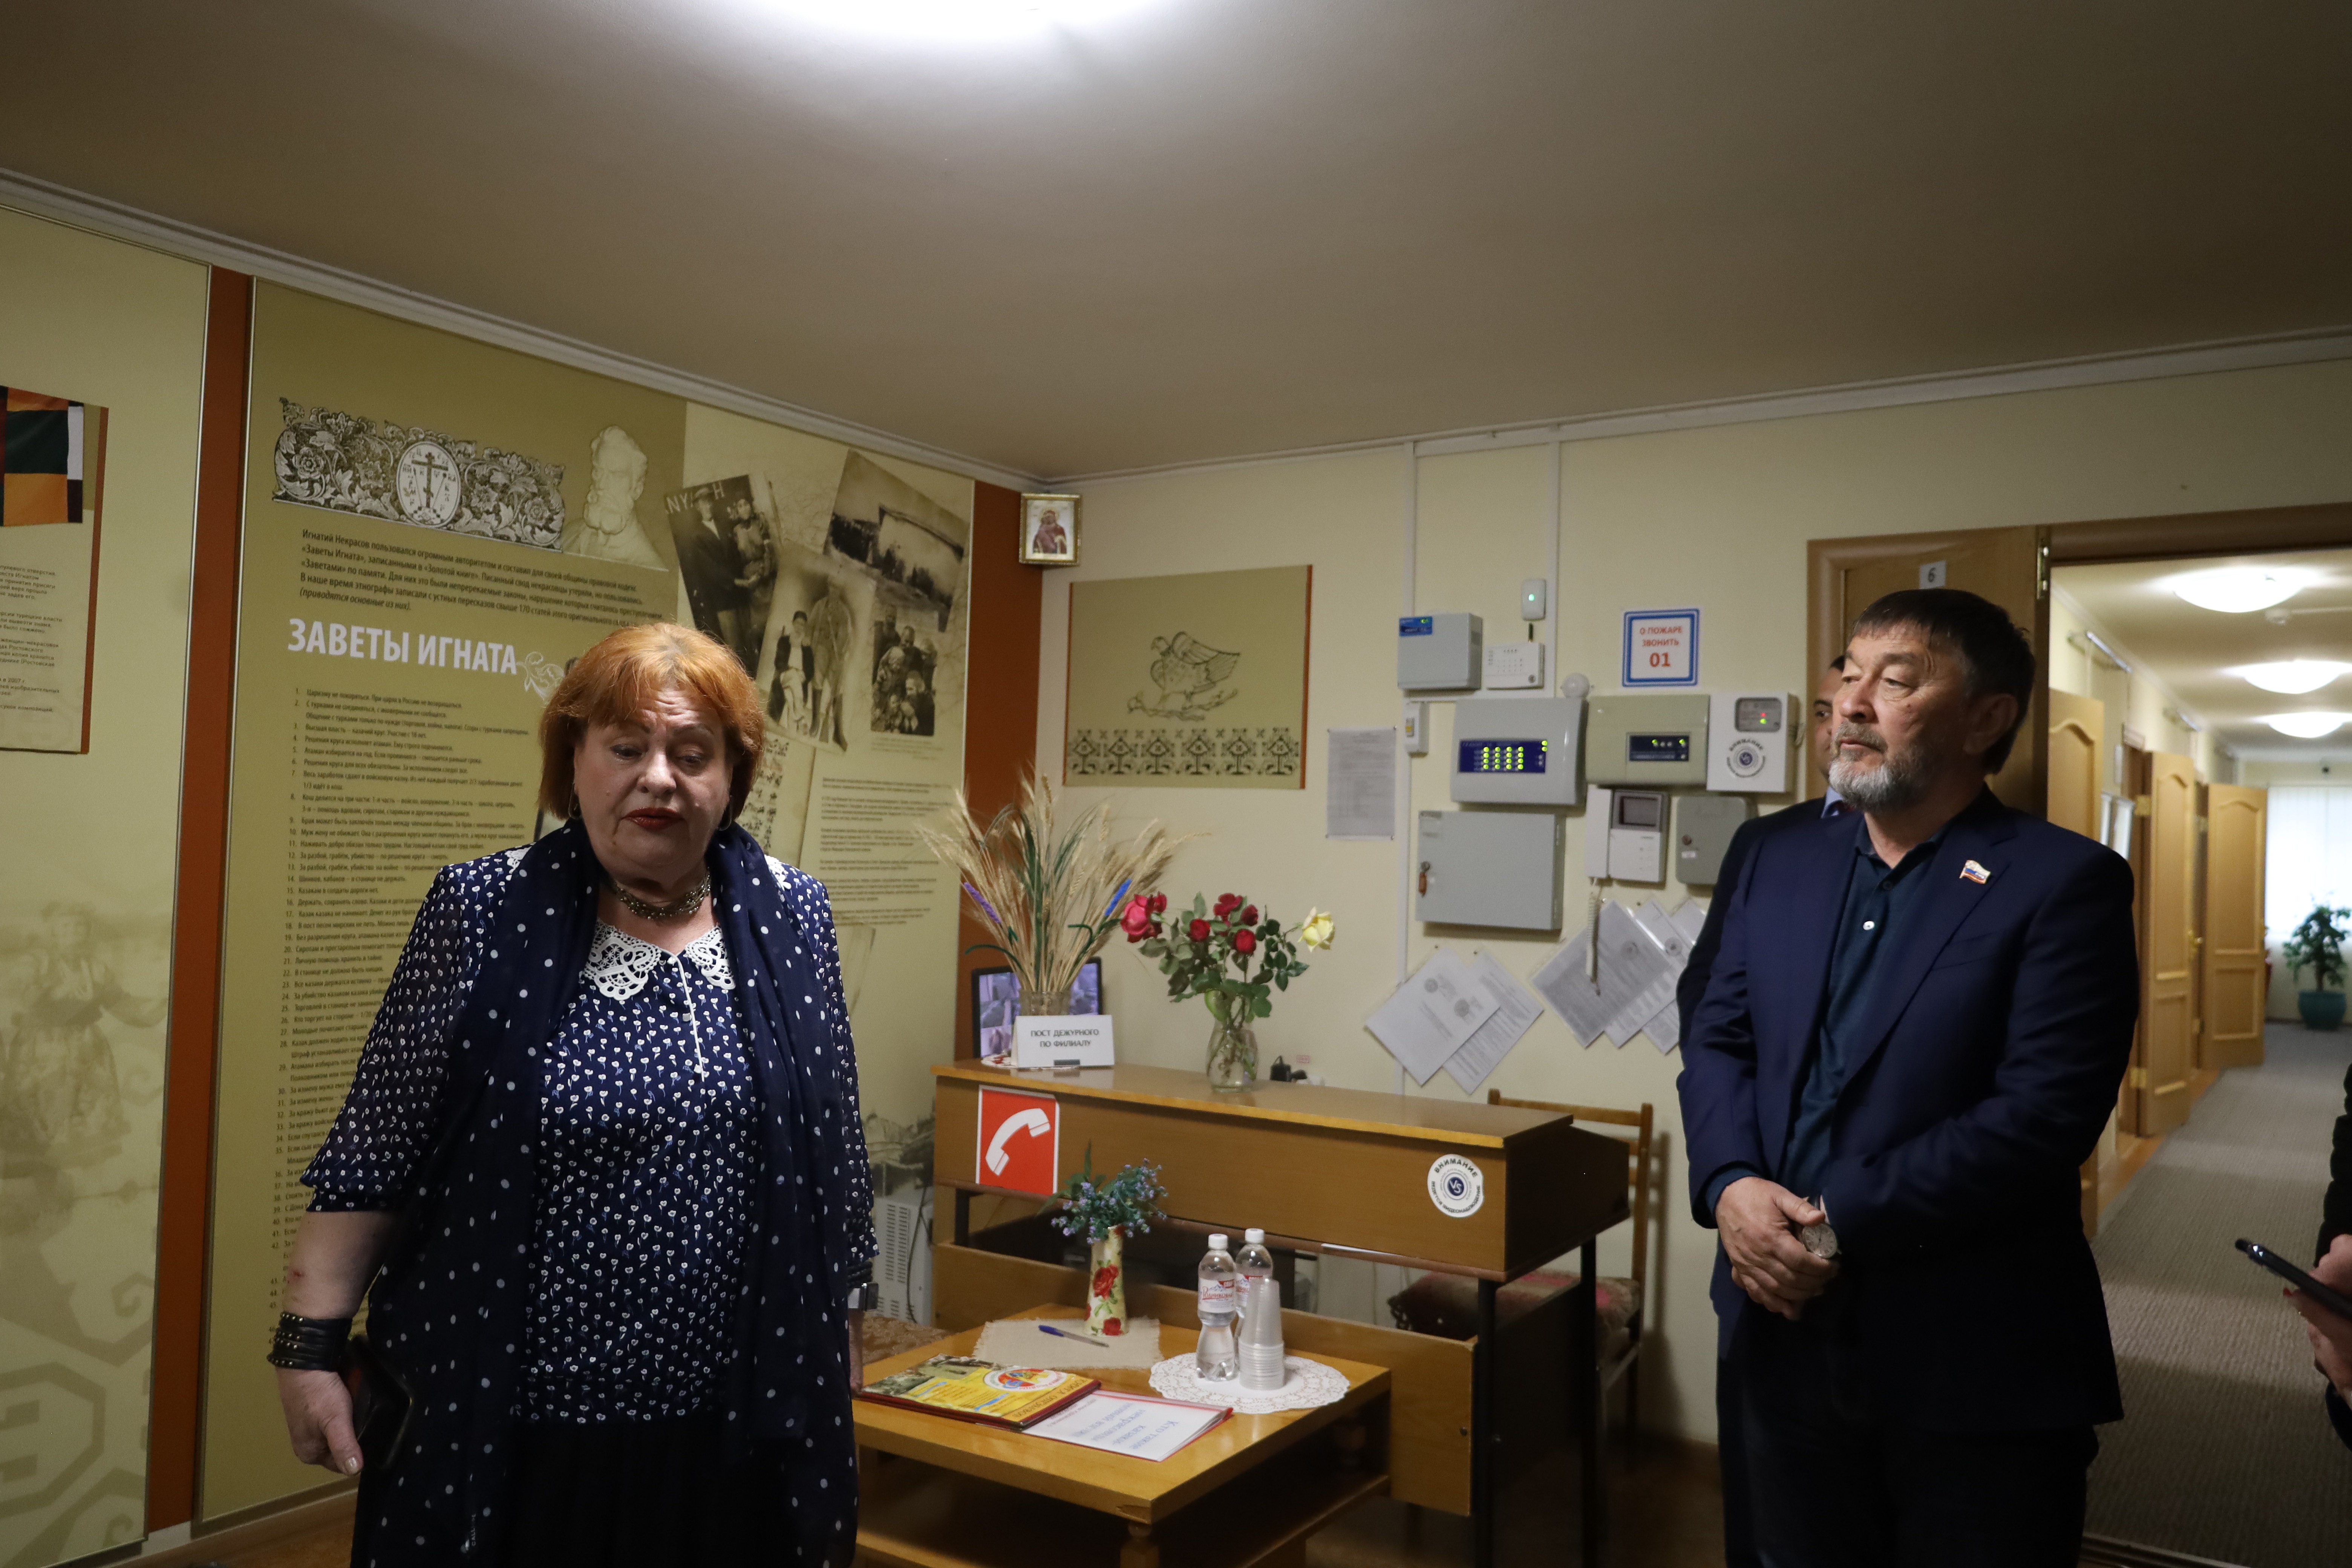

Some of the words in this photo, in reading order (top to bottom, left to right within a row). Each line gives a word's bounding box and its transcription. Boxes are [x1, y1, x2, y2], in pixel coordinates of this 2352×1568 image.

[302, 529, 333, 542] Игнатий
[335, 534, 370, 549] Некрасов
[371, 542, 416, 556] пользовался
[417, 550, 453, 562] огромным
[455, 556, 496, 569] авторитетом
[531, 568, 543, 577] для
[302, 544, 334, 557] «Заветы
[335, 549, 366, 563] Игната»,
[368, 556, 416, 569] записанными
[424, 564, 455, 576] «Золотой
[302, 558, 346, 572] «Заветами»
[348, 567, 357, 575] по
[358, 568, 387, 579] памяти.
[388, 571, 402, 582] Для
[404, 575, 416, 583] них
[430, 577, 448, 588] были
[1928, 567, 1936, 583] 6
[300, 573, 306, 582] В
[308, 574, 328, 584] наше
[329, 578, 354, 589] время
[355, 581, 394, 595] этнографы
[395, 589, 427, 600] записали
[433, 594, 456, 604] устных
[519, 605, 529, 614] 170
[300, 587, 349, 602] (приводятся
[350, 595, 384, 606] основные
[1648, 626, 1683, 634] ПОЖАРЕ
[9, 645, 43, 653] Ростовского
[287, 618, 409, 663] ЗАВЕТЫ
[417, 634, 517, 675] ИГНАТА
[1642, 639, 1679, 647] ЗВОНИТЬ
[1649, 652, 1671, 667] 01
[1054, 1029, 1099, 1037] ДЕЖУРНОГО
[1434, 1158, 1478, 1178] ВНИМАНИЕ
[1449, 1179, 1462, 1193] VS
[1442, 1184, 1481, 1214] ВИДЕОНАБЛЮДЕНИЕ
[1155, 1420, 1179, 1433] Кто
[1130, 1433, 1157, 1449] такие
